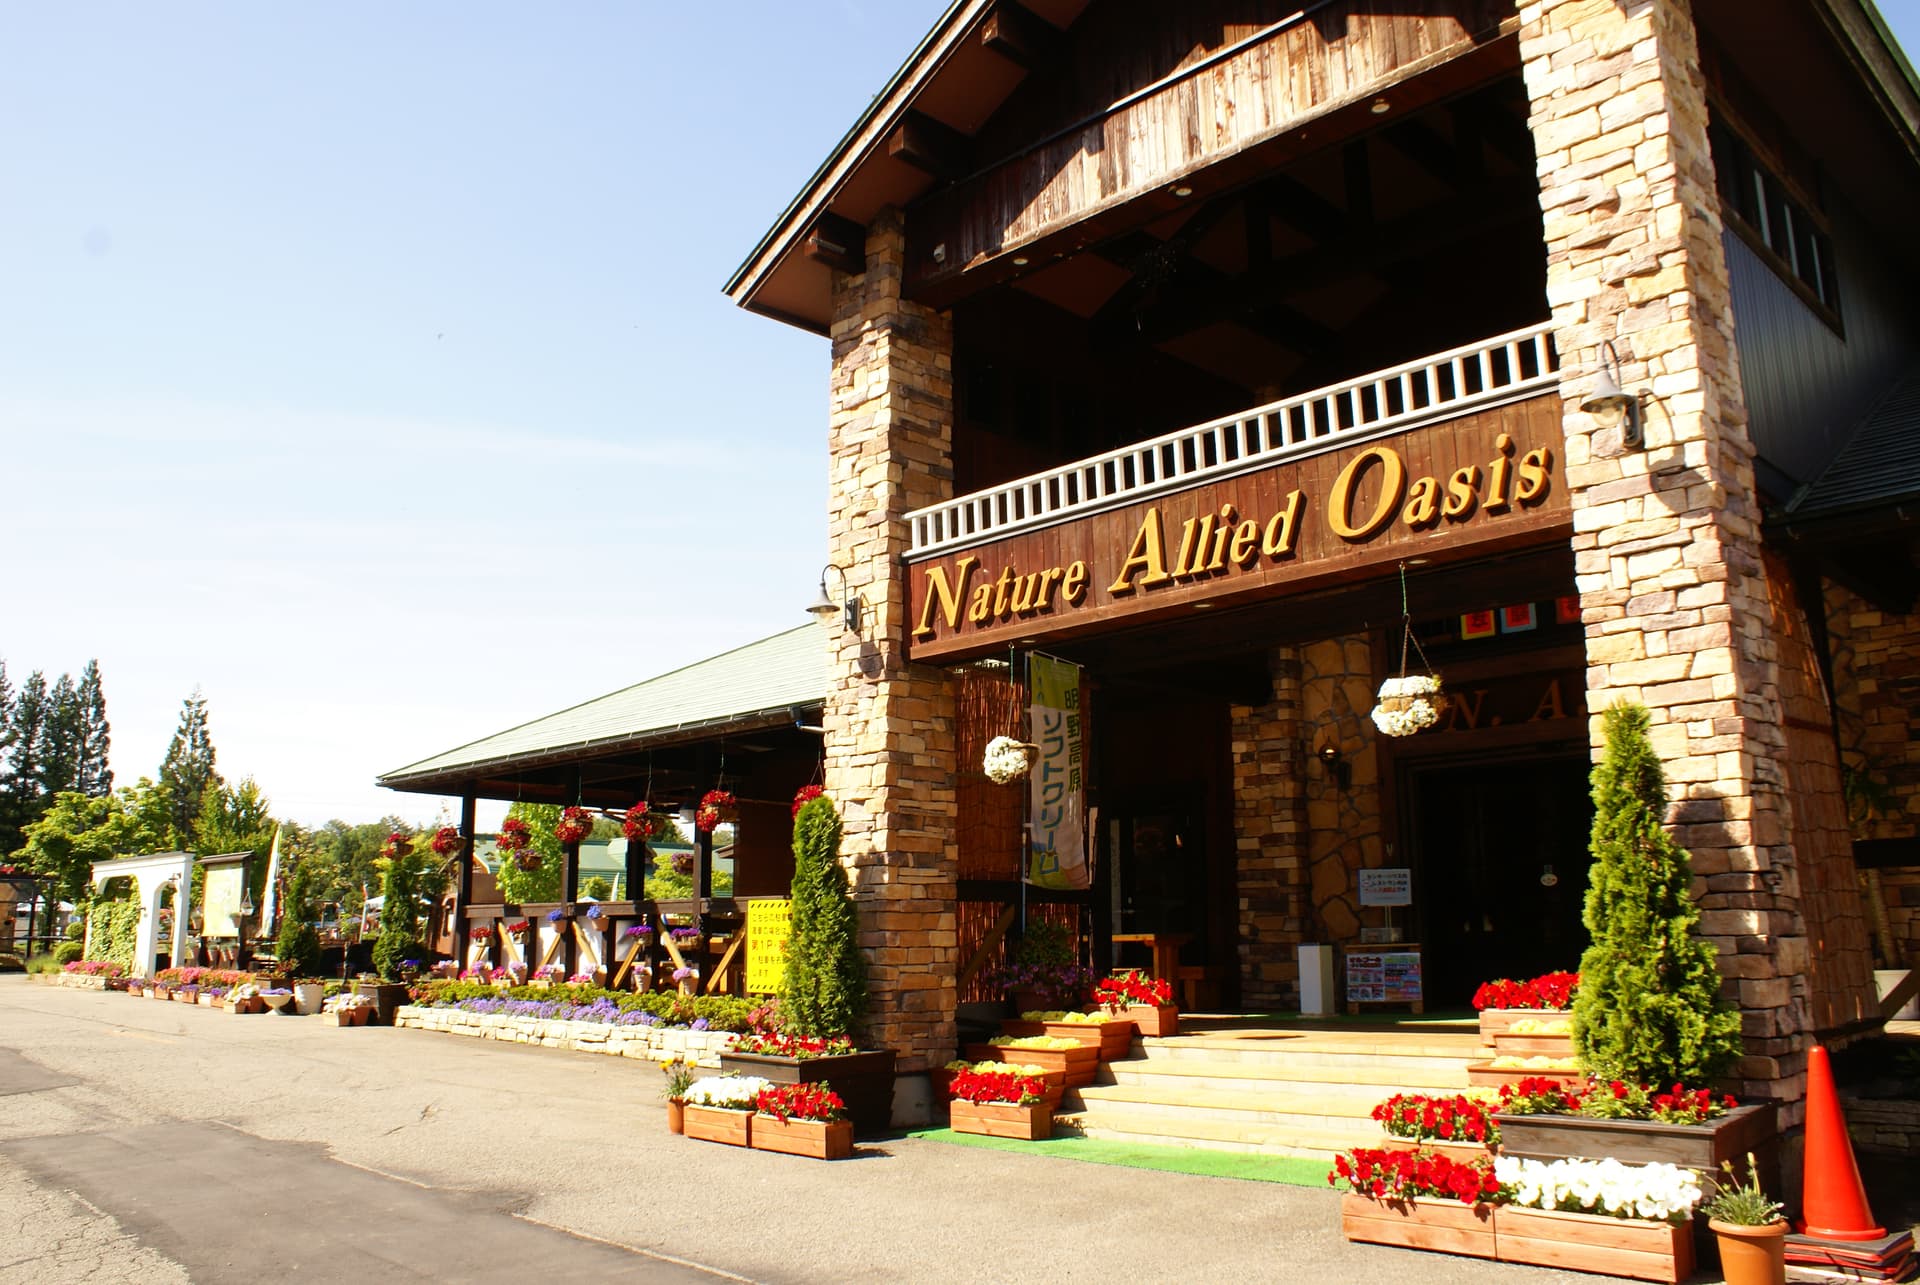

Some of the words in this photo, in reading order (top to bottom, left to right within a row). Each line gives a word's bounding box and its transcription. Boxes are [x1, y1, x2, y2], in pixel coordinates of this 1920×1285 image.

[912, 556, 1090, 637] Nature
[1107, 489, 1305, 593] Allied
[1328, 433, 1553, 539] Oasis
[1039, 711, 1064, 875] ソフトクリーム
